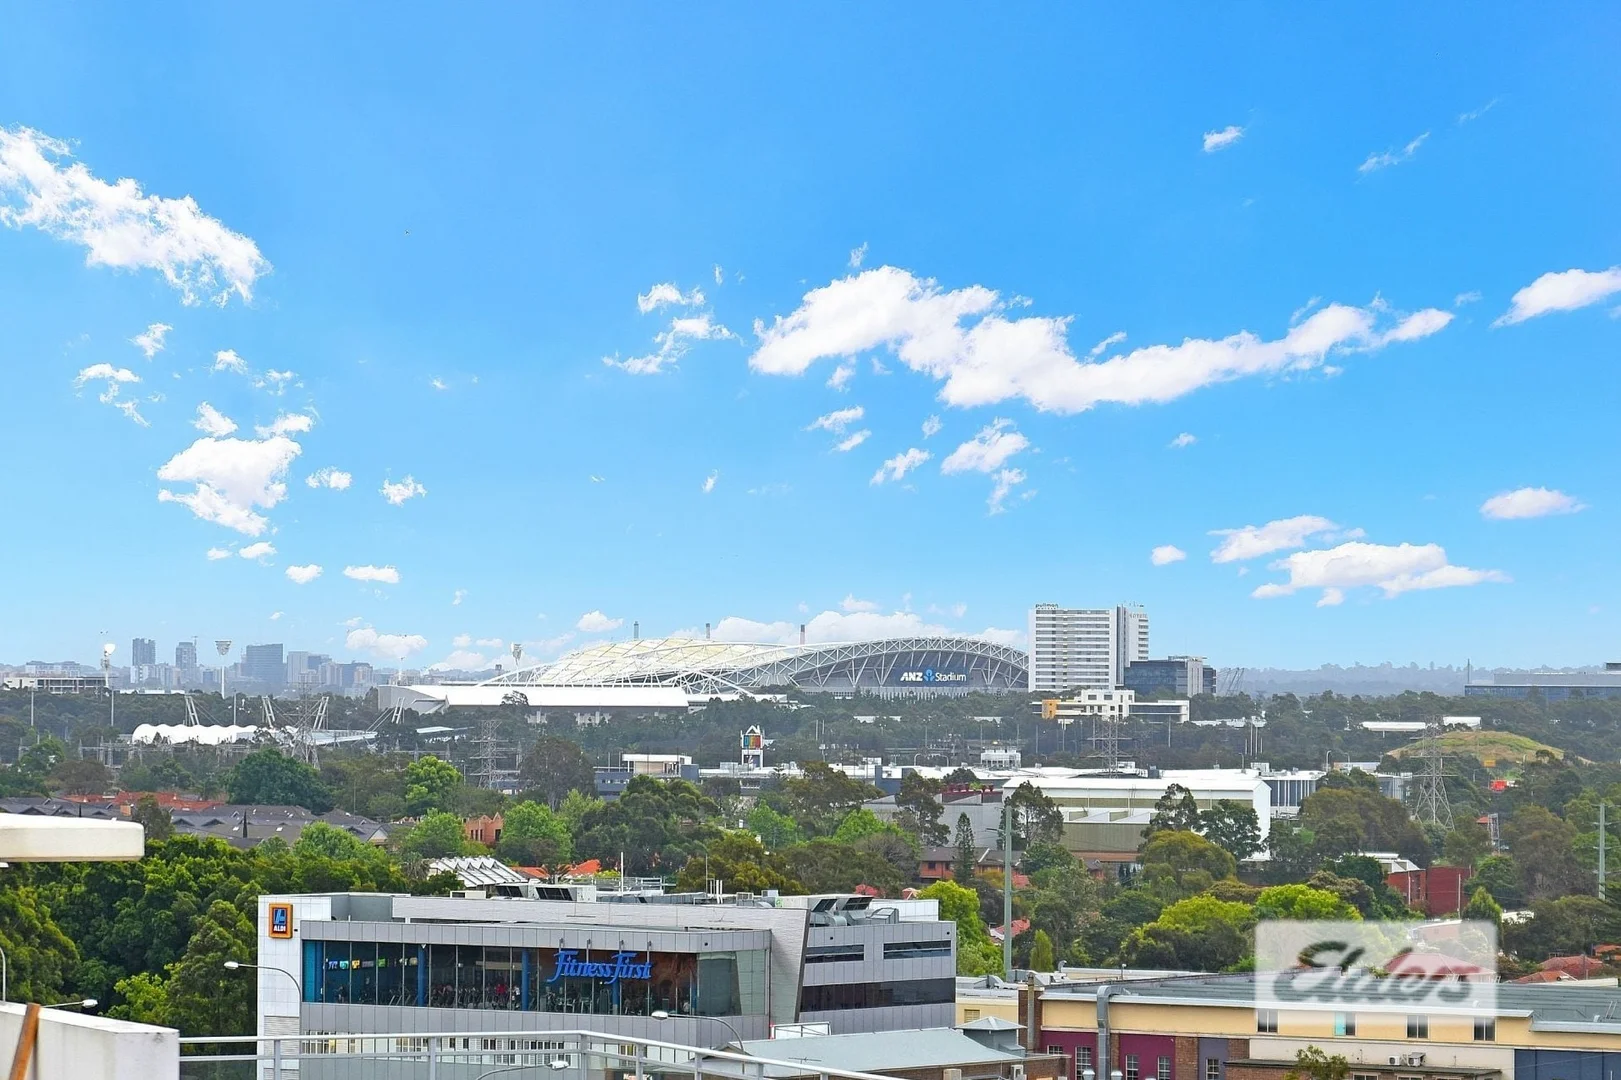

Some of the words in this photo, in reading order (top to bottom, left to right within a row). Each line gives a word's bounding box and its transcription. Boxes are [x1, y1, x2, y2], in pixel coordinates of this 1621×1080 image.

[900, 672, 923, 681] ANZ
[935, 672, 967, 682] Stadium
[546, 950, 613, 982] Fitness
[604, 952, 652, 984] First
